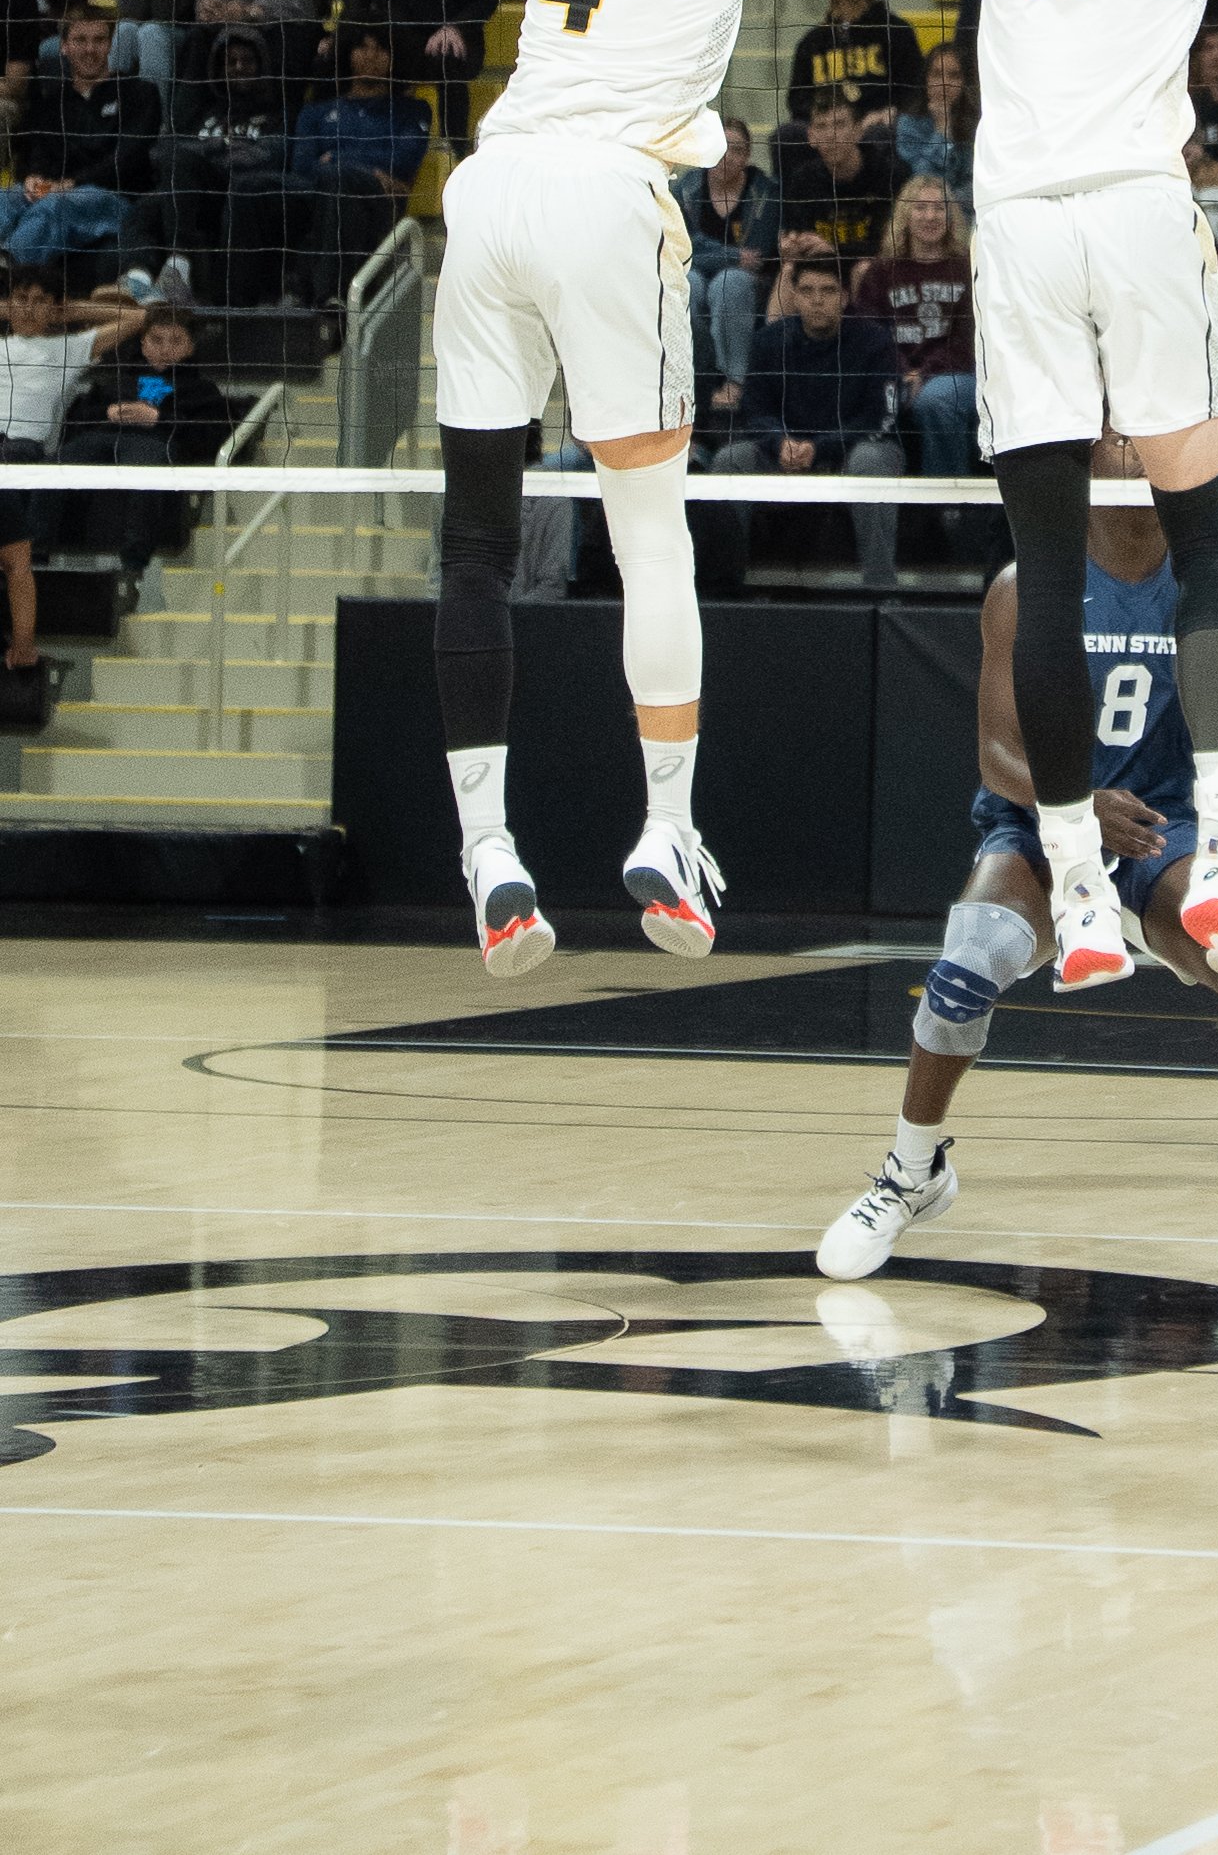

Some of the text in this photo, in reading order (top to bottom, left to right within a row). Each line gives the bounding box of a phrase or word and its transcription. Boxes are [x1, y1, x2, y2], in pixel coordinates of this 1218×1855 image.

[1083, 634, 1177, 655] ENN STAT
[1097, 664, 1154, 747] 8
